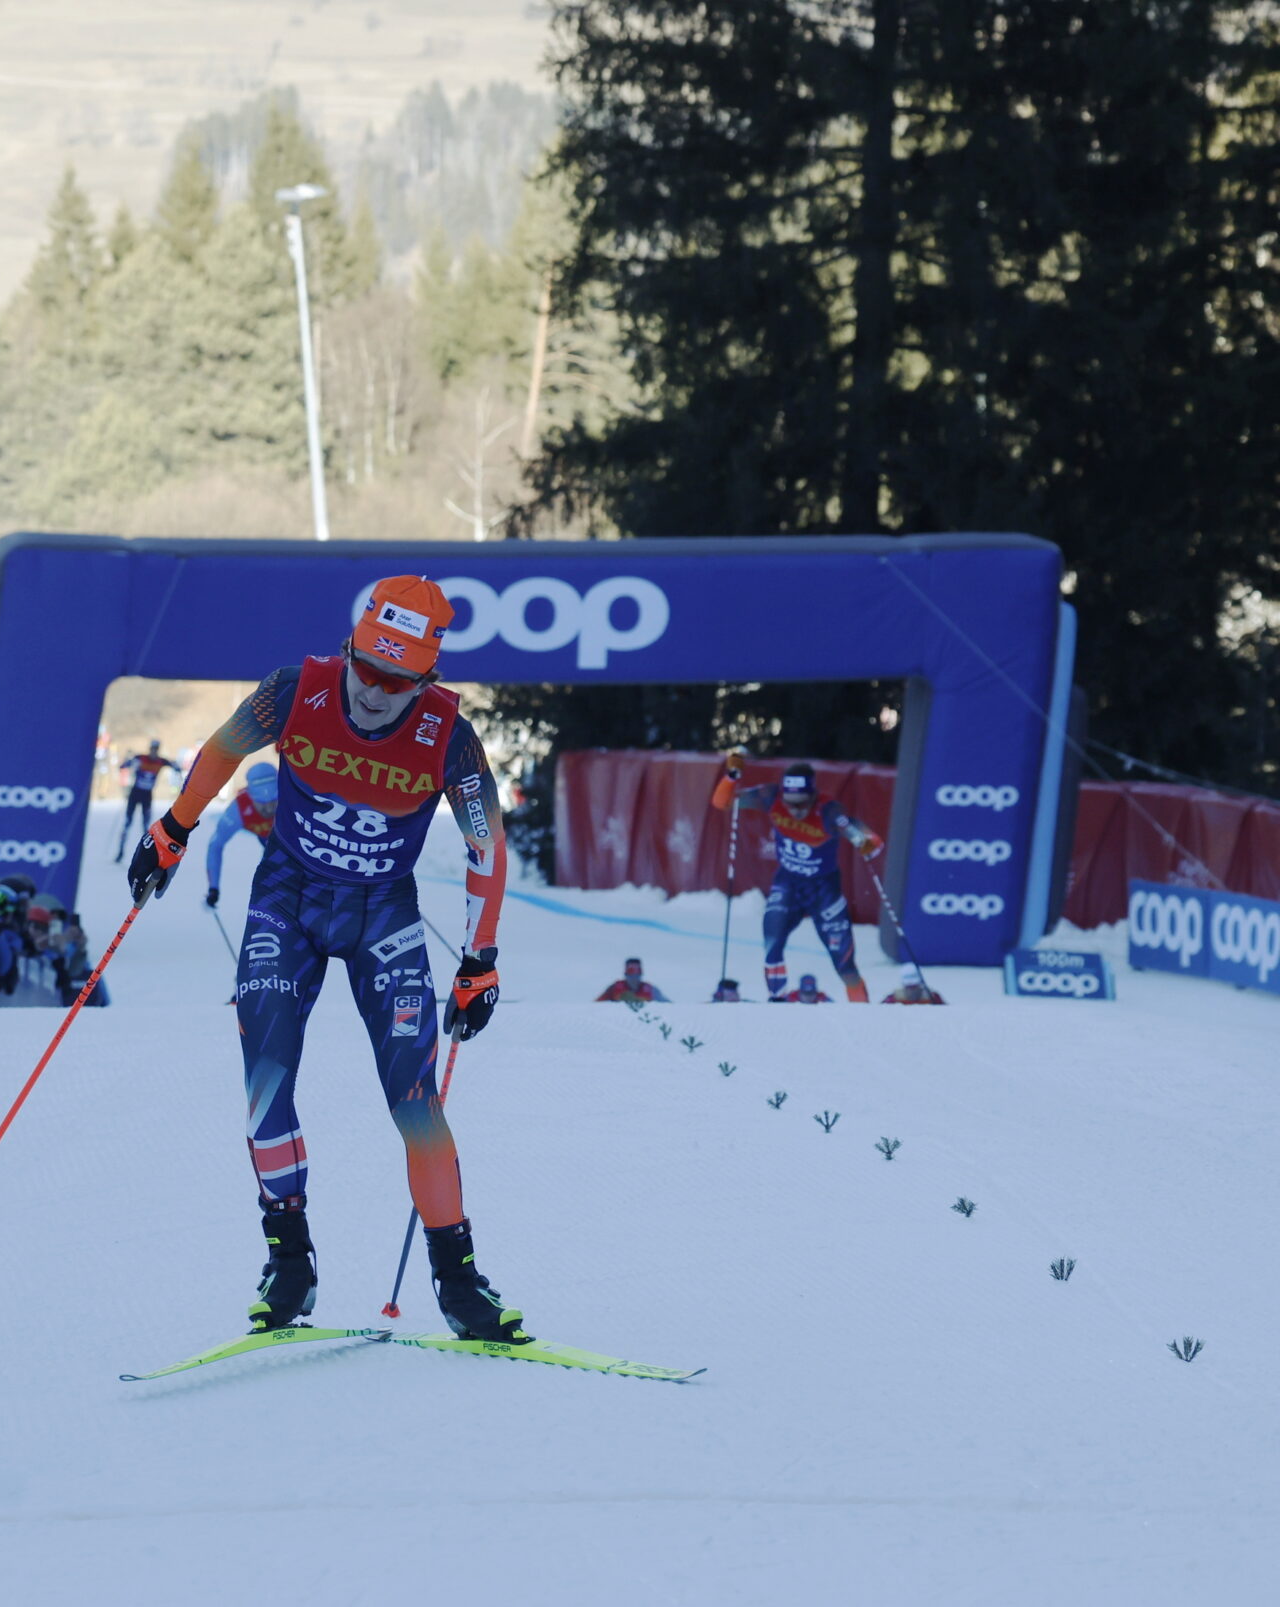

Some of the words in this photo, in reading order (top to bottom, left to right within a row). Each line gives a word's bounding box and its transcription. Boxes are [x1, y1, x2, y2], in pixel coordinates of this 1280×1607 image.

[316, 747, 435, 795] EXTRA
[935, 784, 1020, 812] coop
[312, 795, 388, 838] 28
[469, 800, 489, 839] GEILO
[298, 837, 396, 877] coop
[782, 837, 813, 860] 19
[927, 838, 1012, 866] coop
[920, 893, 1005, 920] coop
[1130, 890, 1203, 967] coop
[1211, 902, 1280, 983] coop
[239, 974, 291, 999] pexip
[1018, 970, 1100, 997] coop
[395, 997, 421, 1009] GB
[482, 1342, 512, 1354] FISCHER
